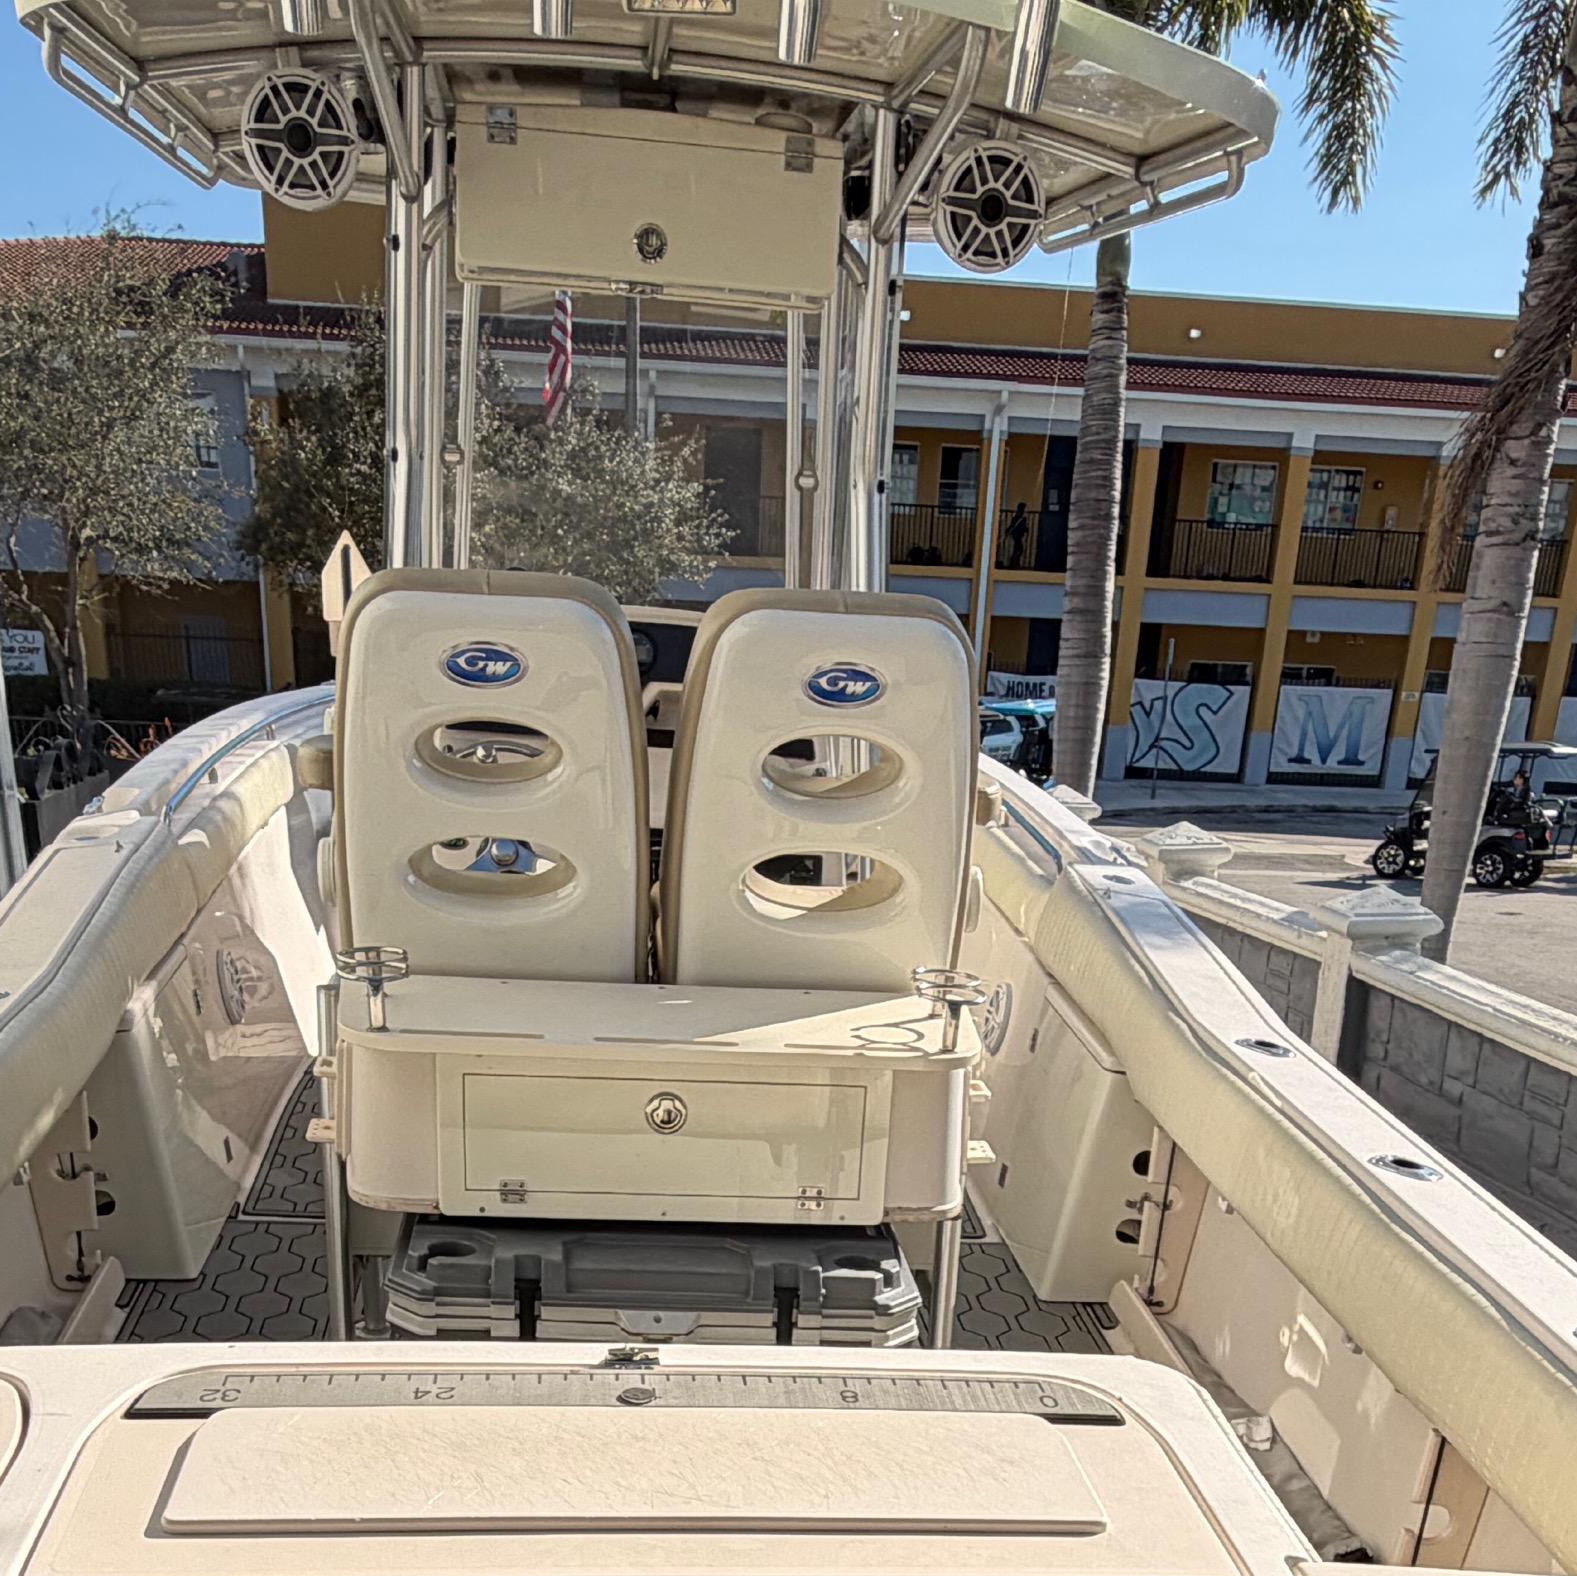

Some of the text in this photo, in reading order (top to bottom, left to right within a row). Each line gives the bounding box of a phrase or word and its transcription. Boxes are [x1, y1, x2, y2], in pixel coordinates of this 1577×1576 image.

[1005, 680, 1046, 699] HOME
[198, 1387, 242, 1403] 32
[412, 1386, 456, 1401] 24
[839, 1389, 860, 1404] 8
